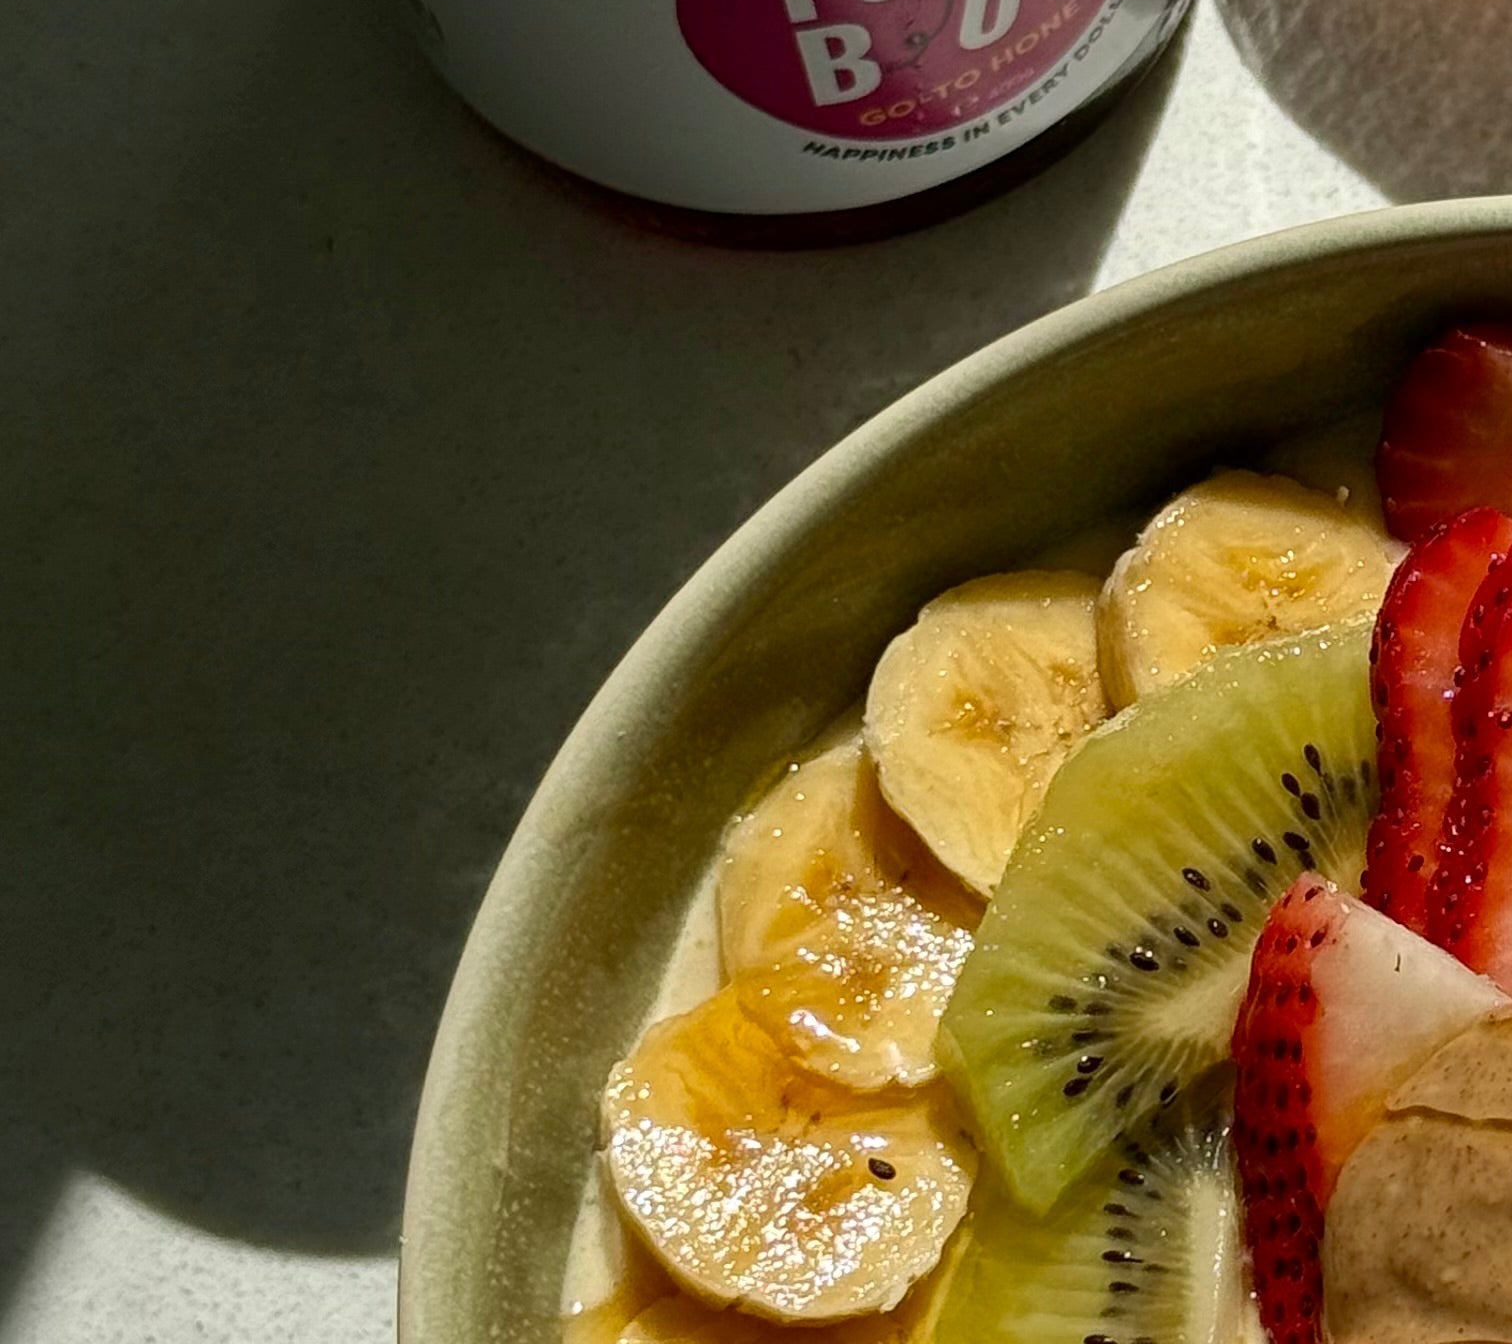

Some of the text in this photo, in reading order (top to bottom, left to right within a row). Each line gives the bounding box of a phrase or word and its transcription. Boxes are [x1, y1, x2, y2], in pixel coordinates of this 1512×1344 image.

[802, 136, 956, 163] HAPPINESS
[963, 123, 991, 143] IN
[998, 63, 1070, 127] EVERY
